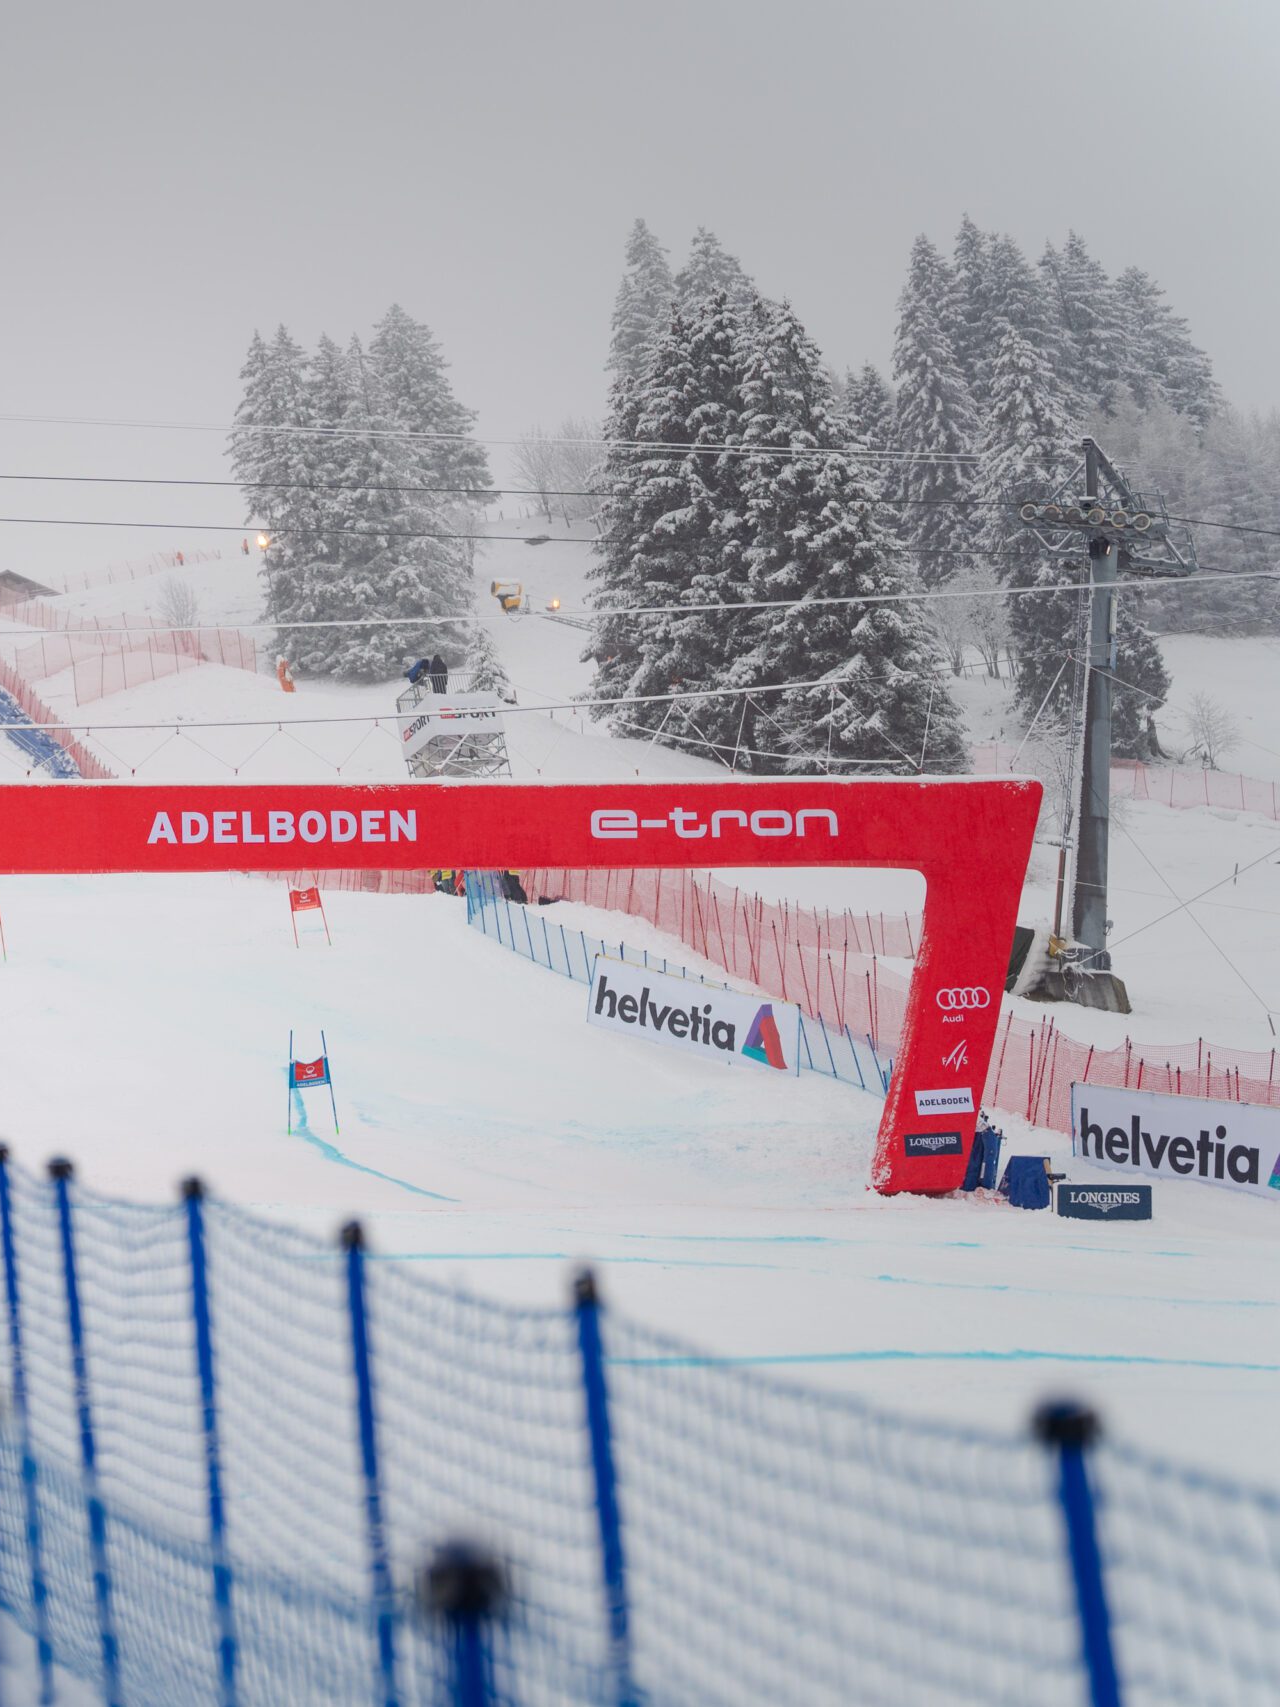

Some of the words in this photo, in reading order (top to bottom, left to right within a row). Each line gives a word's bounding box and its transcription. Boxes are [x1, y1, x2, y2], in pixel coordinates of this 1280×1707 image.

[147, 809, 417, 844] ADELBODEN
[590, 807, 839, 838] e-tron
[594, 975, 736, 1052] helvetia
[942, 1014, 965, 1024] Audi
[919, 1096, 970, 1107] ADELBODEN
[909, 1136, 958, 1147] LONGINES
[1080, 1107, 1260, 1185] helvetia
[1069, 1191, 1141, 1205] LONGINES
